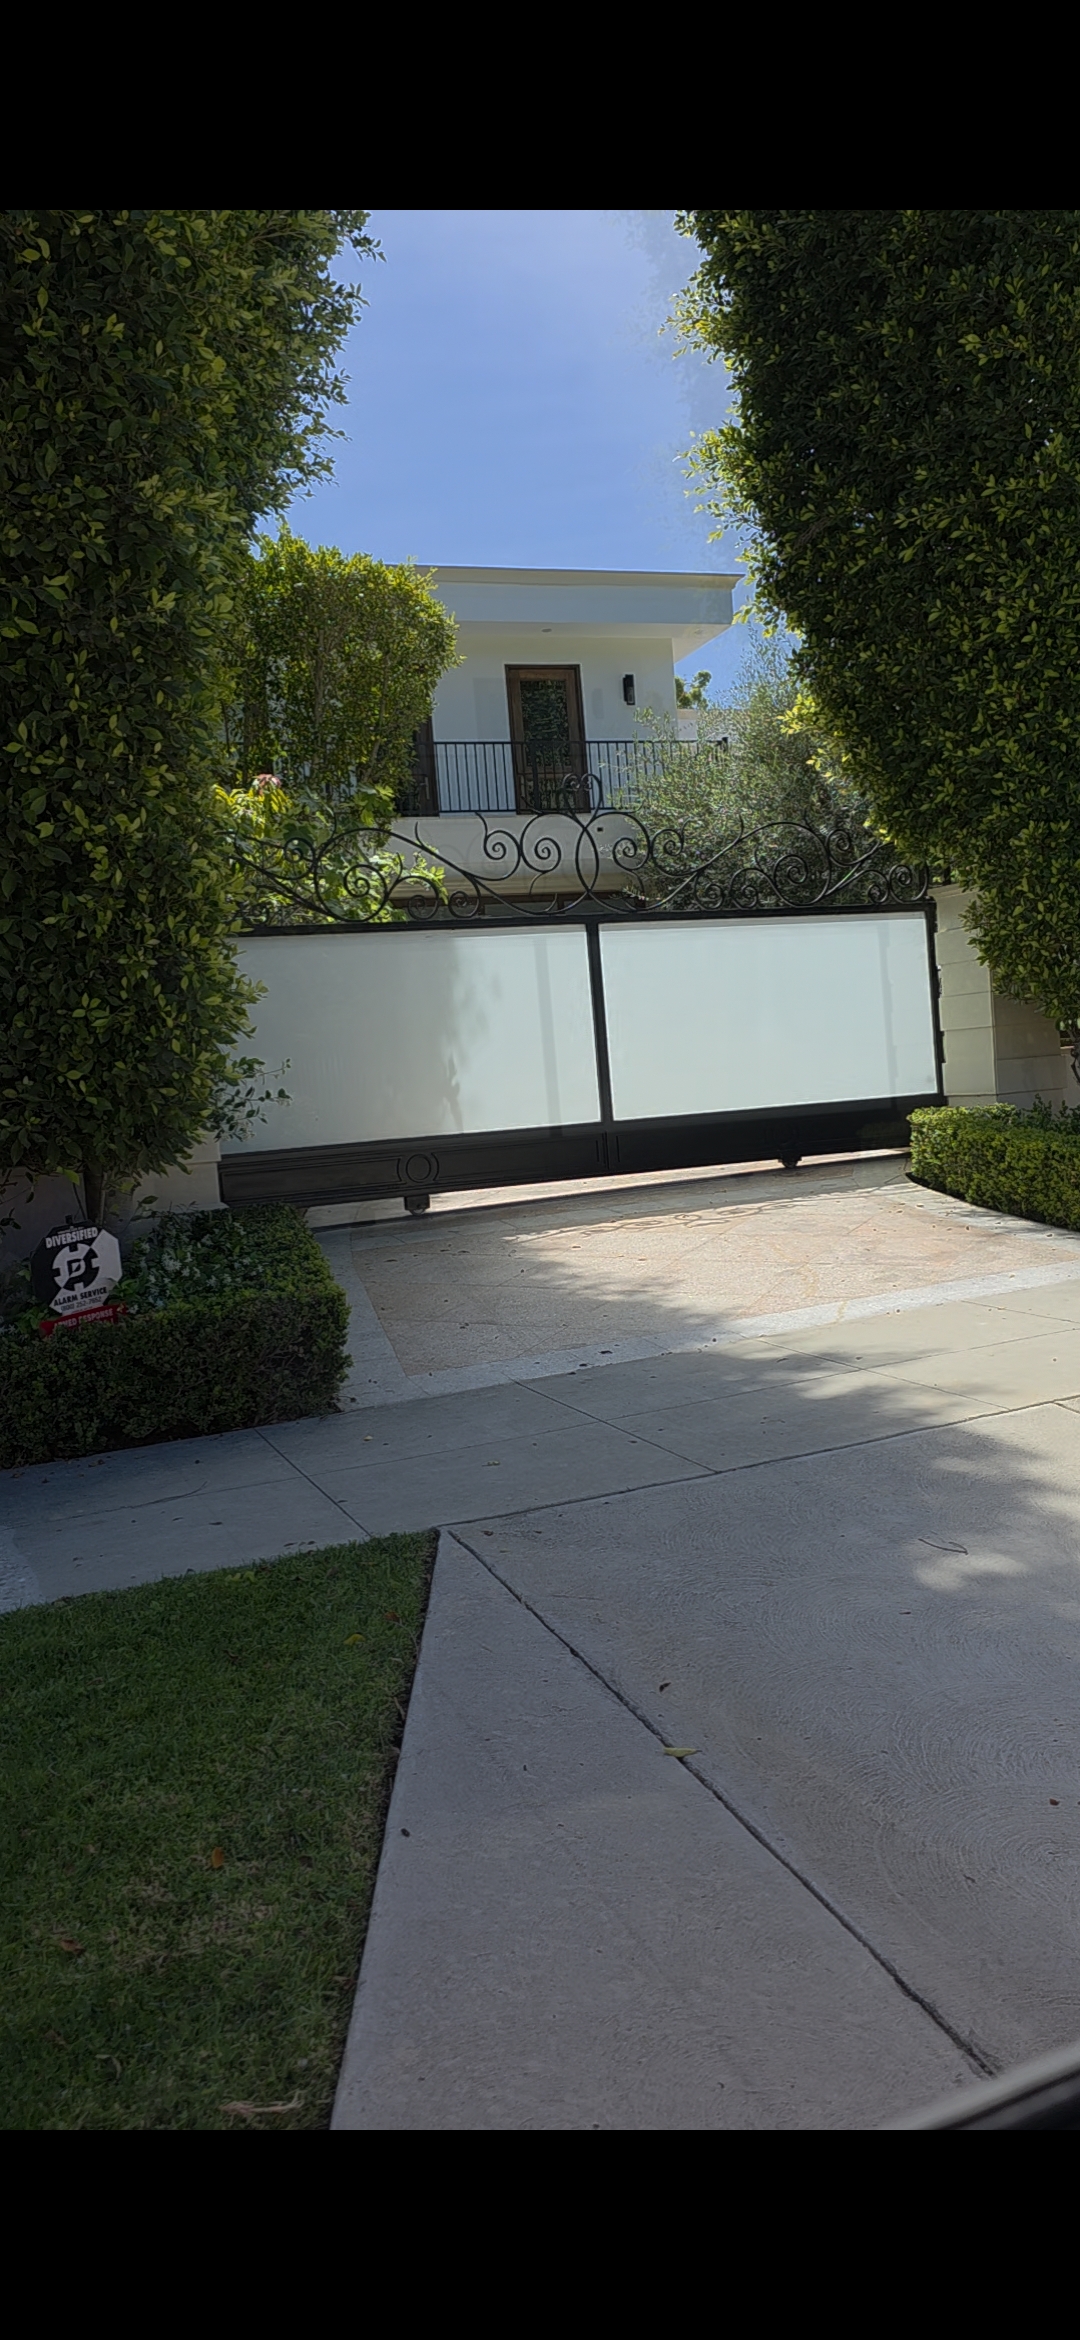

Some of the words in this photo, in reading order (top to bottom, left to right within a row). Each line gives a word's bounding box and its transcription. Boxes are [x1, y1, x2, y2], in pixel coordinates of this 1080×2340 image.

[45, 1226, 98, 1249] DIVERSIFIED
[53, 1294, 78, 1307] ALARM
[80, 1286, 107, 1300] SERVICE
